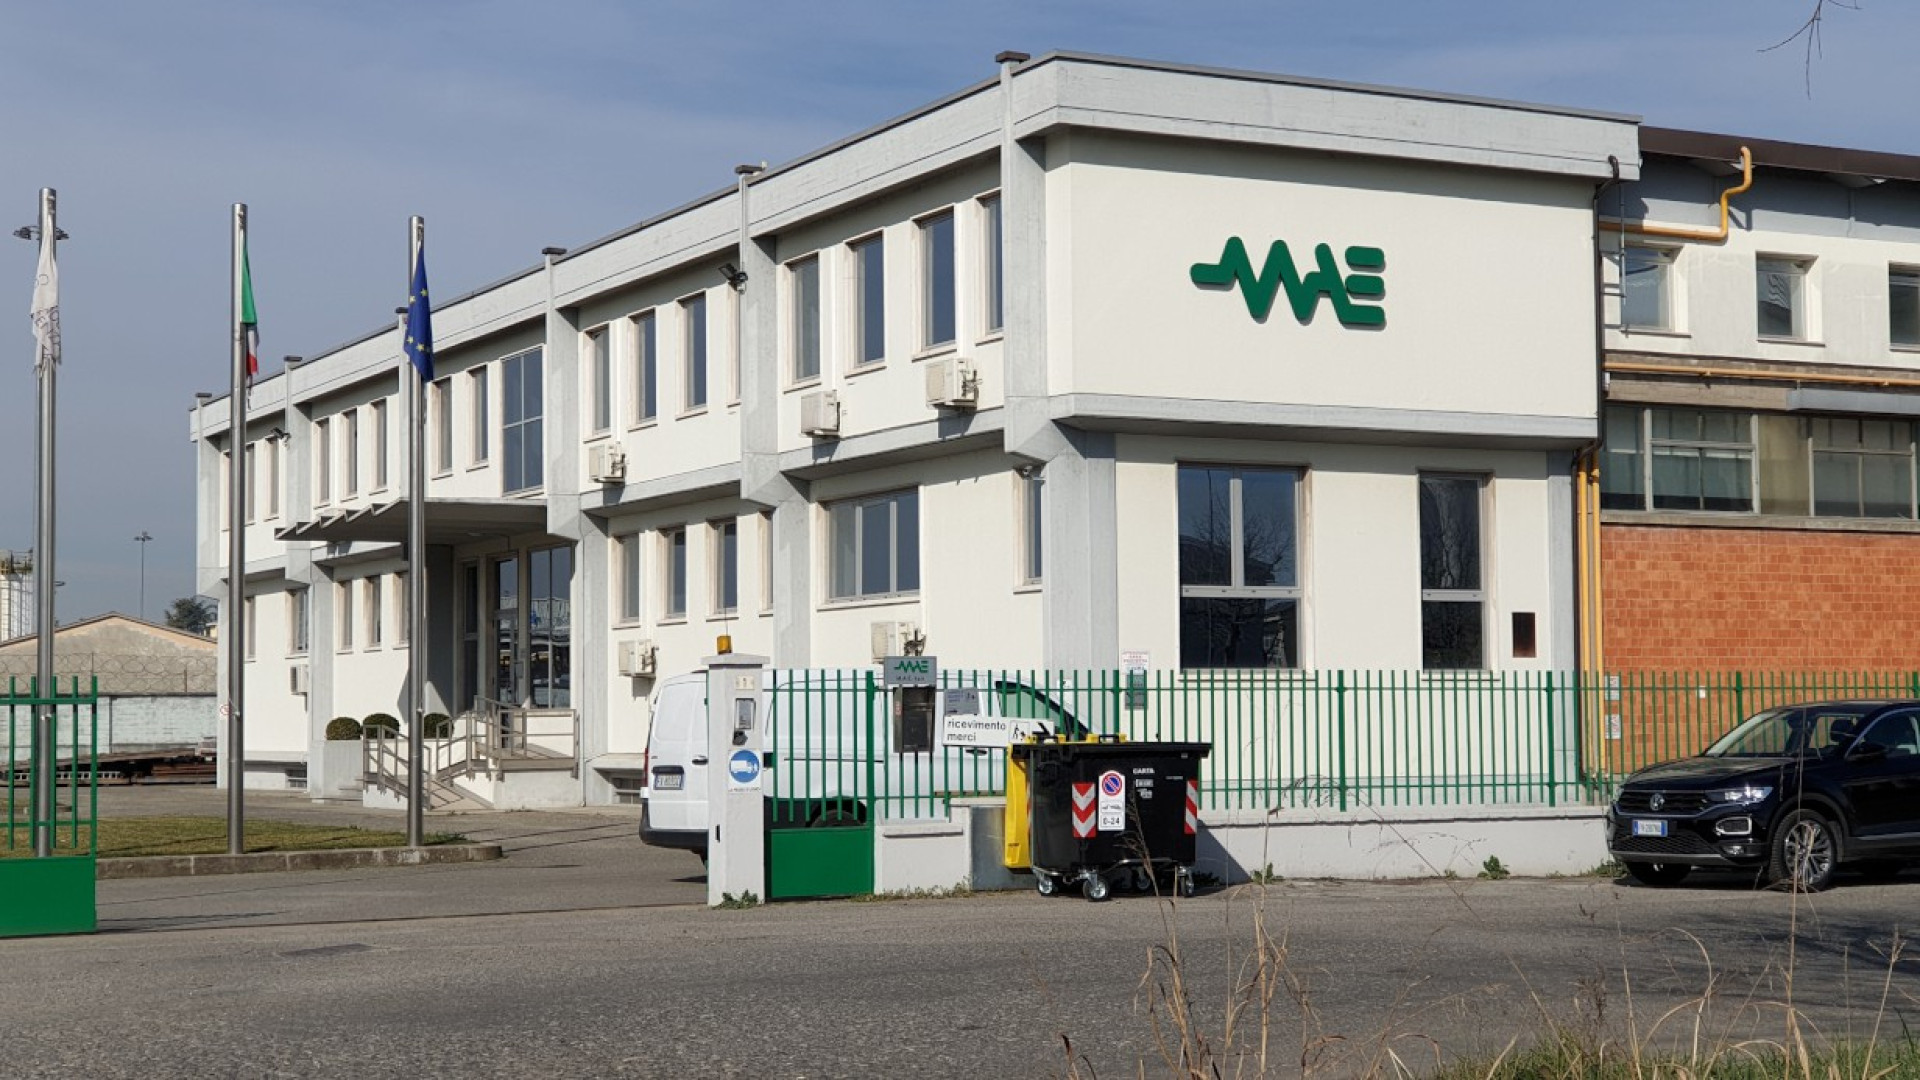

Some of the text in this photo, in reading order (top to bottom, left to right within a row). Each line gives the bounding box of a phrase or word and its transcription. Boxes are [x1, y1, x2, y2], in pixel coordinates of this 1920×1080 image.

[1190, 236, 1386, 329] MAE
[948, 719, 1006, 731] ricevimento
[947, 732, 977, 742] merci
